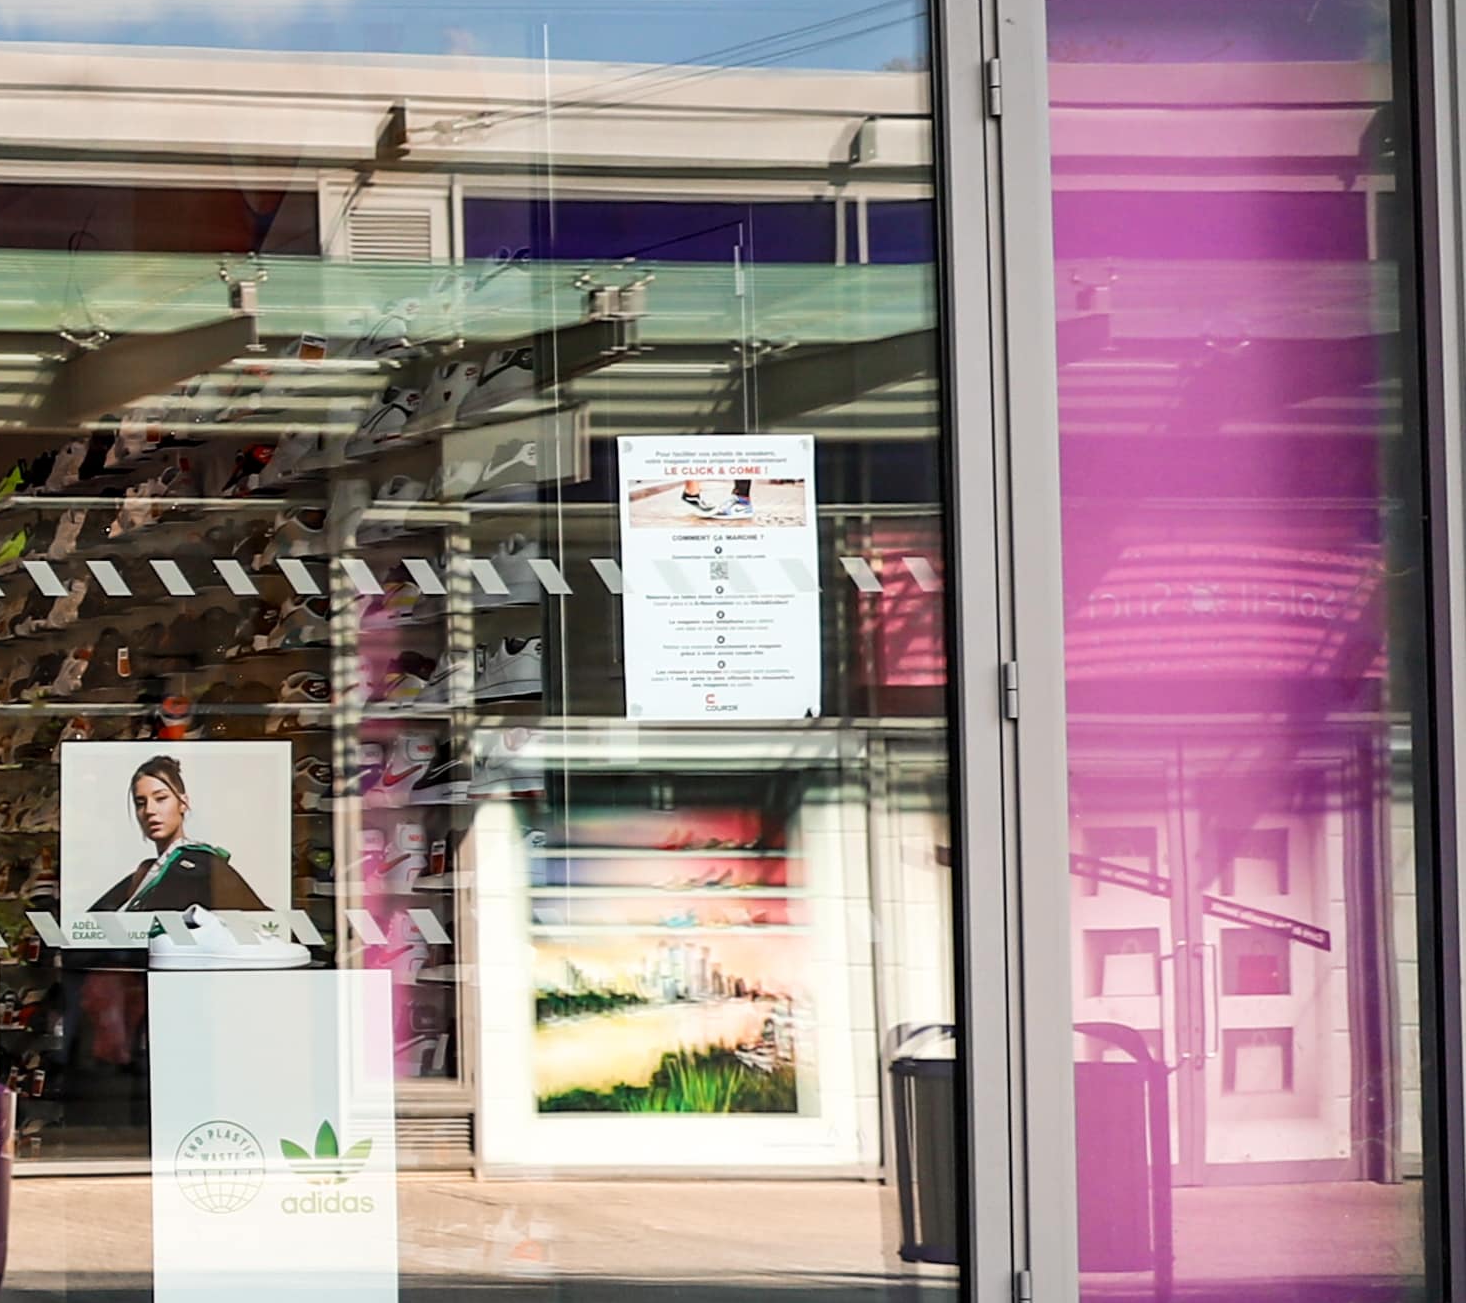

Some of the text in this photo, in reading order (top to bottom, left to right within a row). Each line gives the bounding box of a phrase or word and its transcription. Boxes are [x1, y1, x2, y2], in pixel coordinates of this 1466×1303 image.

[665, 467, 677, 475] LE
[681, 467, 713, 475] CLICK
[729, 467, 761, 475] COME
[183, 1128, 256, 1159] END PLASTIC
[280, 1192, 375, 1215] adidas
